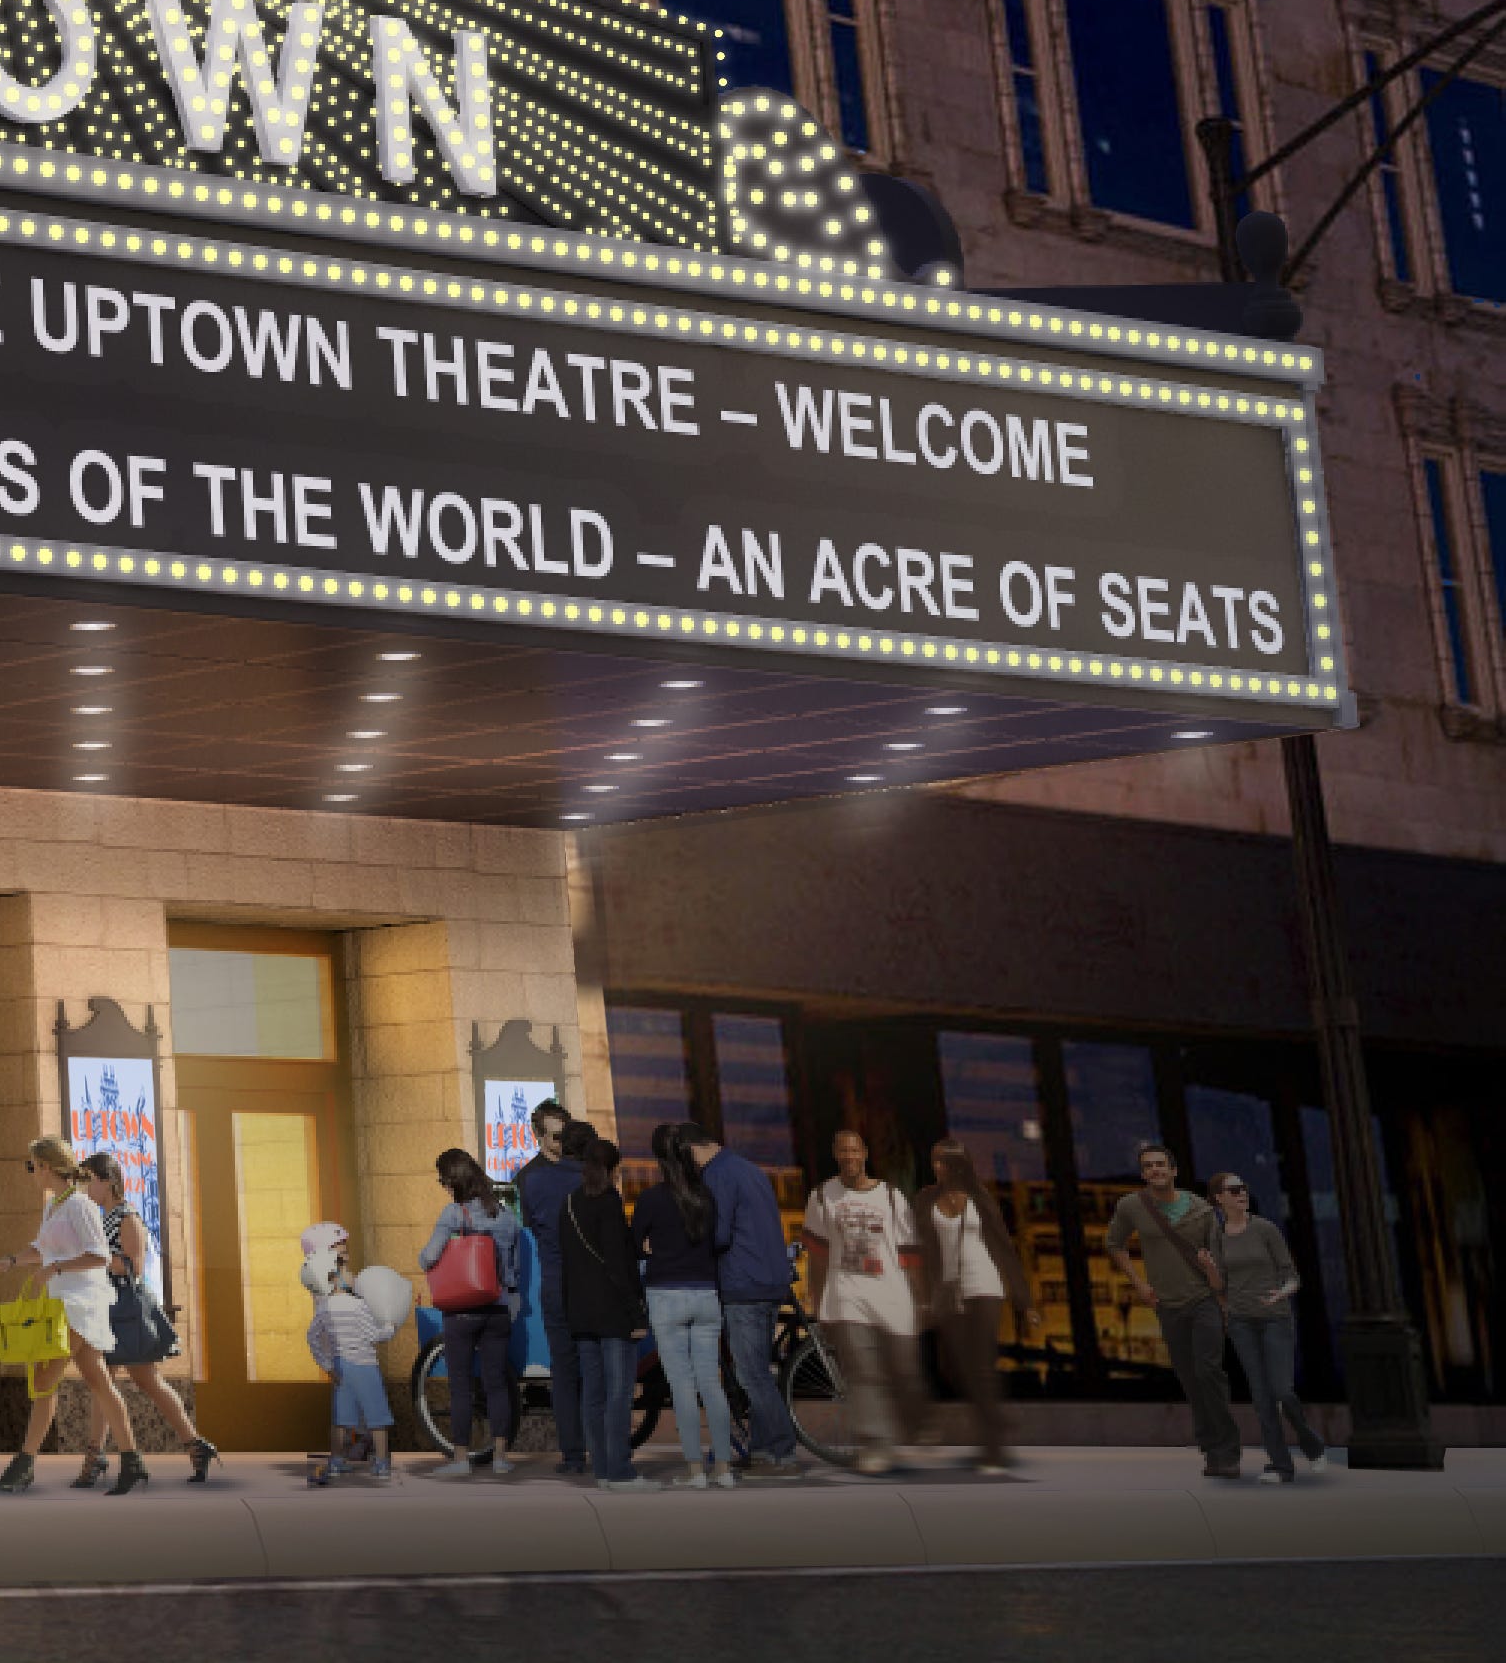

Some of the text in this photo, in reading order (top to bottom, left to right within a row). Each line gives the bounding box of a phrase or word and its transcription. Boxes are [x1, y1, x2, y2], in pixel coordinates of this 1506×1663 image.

[30, 278, 353, 391] UPTOWN
[375, 325, 701, 436] THEATRE
[774, 380, 1094, 488] WELCOME
[69, 449, 167, 528] OF
[192, 461, 338, 550] THE
[357, 482, 614, 577] WORLD
[696, 523, 785, 598] AN
[810, 538, 980, 621] ACRE
[999, 559, 1076, 631] OF
[1098, 571, 1285, 655] SEATS
[71, 1109, 156, 1143] UPTOWN
